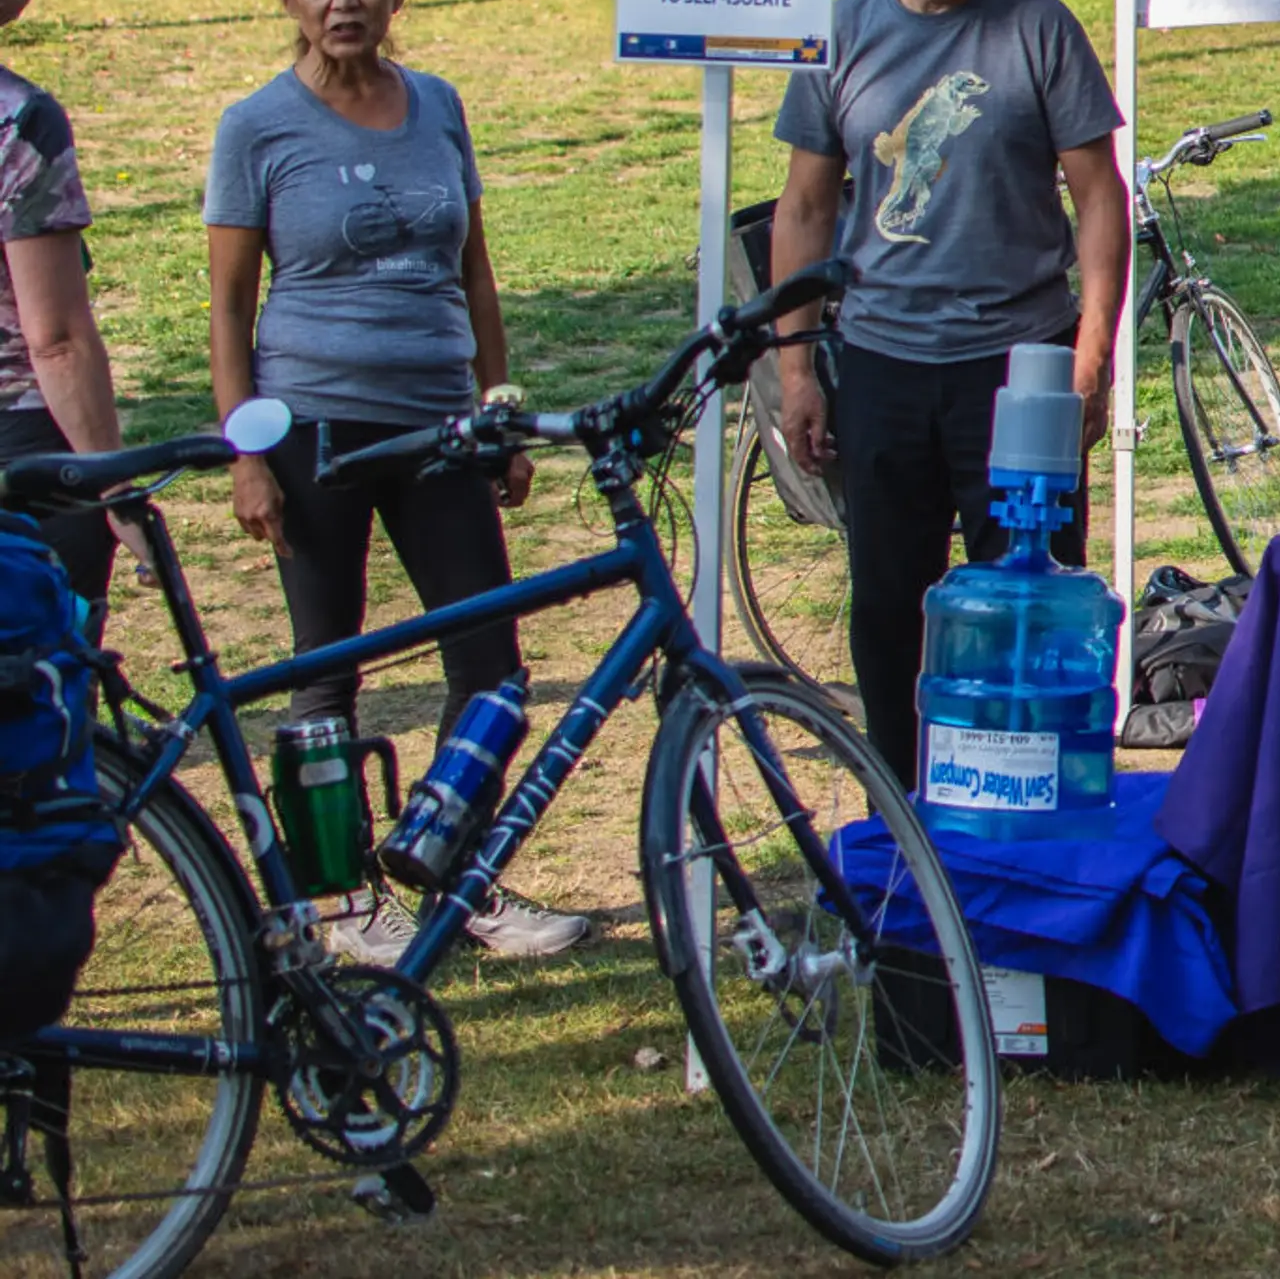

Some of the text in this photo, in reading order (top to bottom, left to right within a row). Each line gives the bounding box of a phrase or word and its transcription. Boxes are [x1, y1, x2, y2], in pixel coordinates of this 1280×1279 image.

[339, 165, 349, 184] I
[930, 754, 981, 799] Company
[983, 772, 1026, 807] Water
